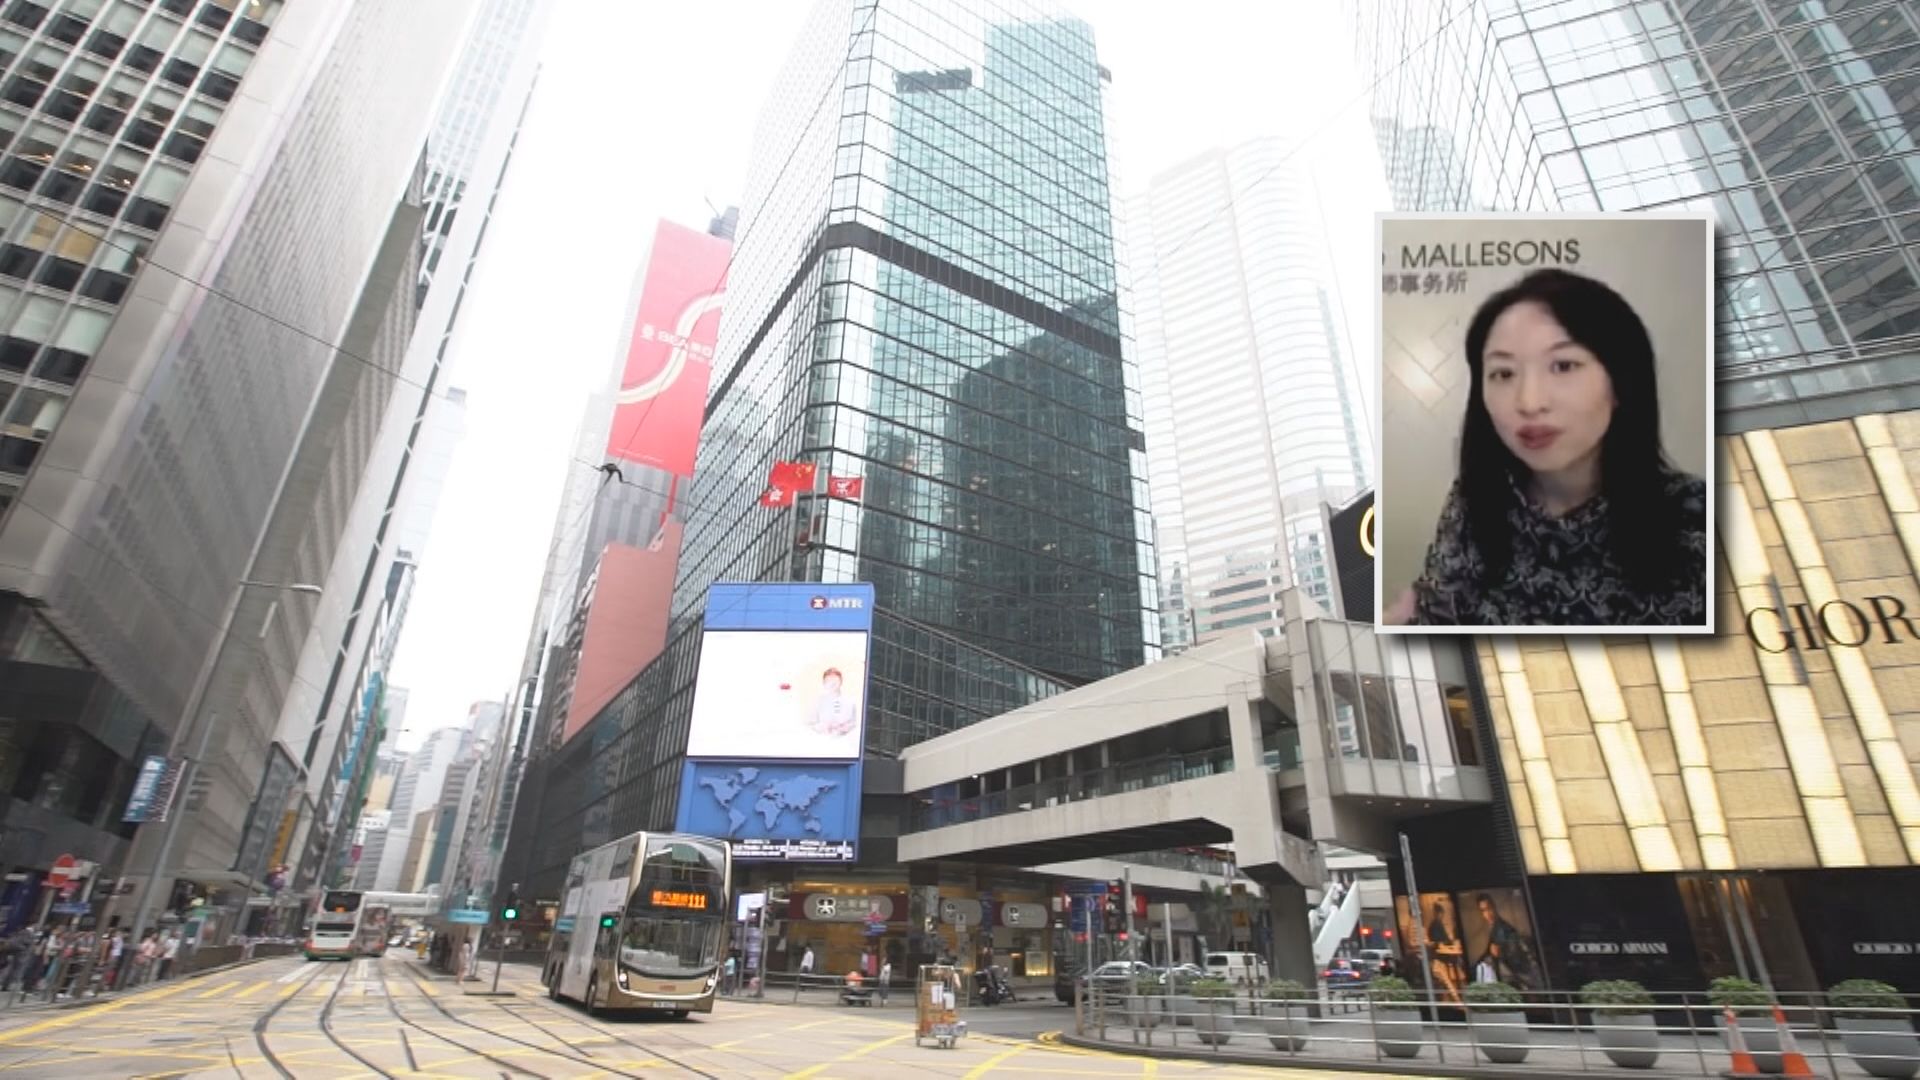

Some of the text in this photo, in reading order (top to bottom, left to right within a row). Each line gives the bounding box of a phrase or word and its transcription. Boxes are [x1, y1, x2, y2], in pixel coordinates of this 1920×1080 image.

[1400, 239, 1580, 268] MALLESONS
[829, 598, 864, 608] MTR
[688, 893, 705, 908] 111
